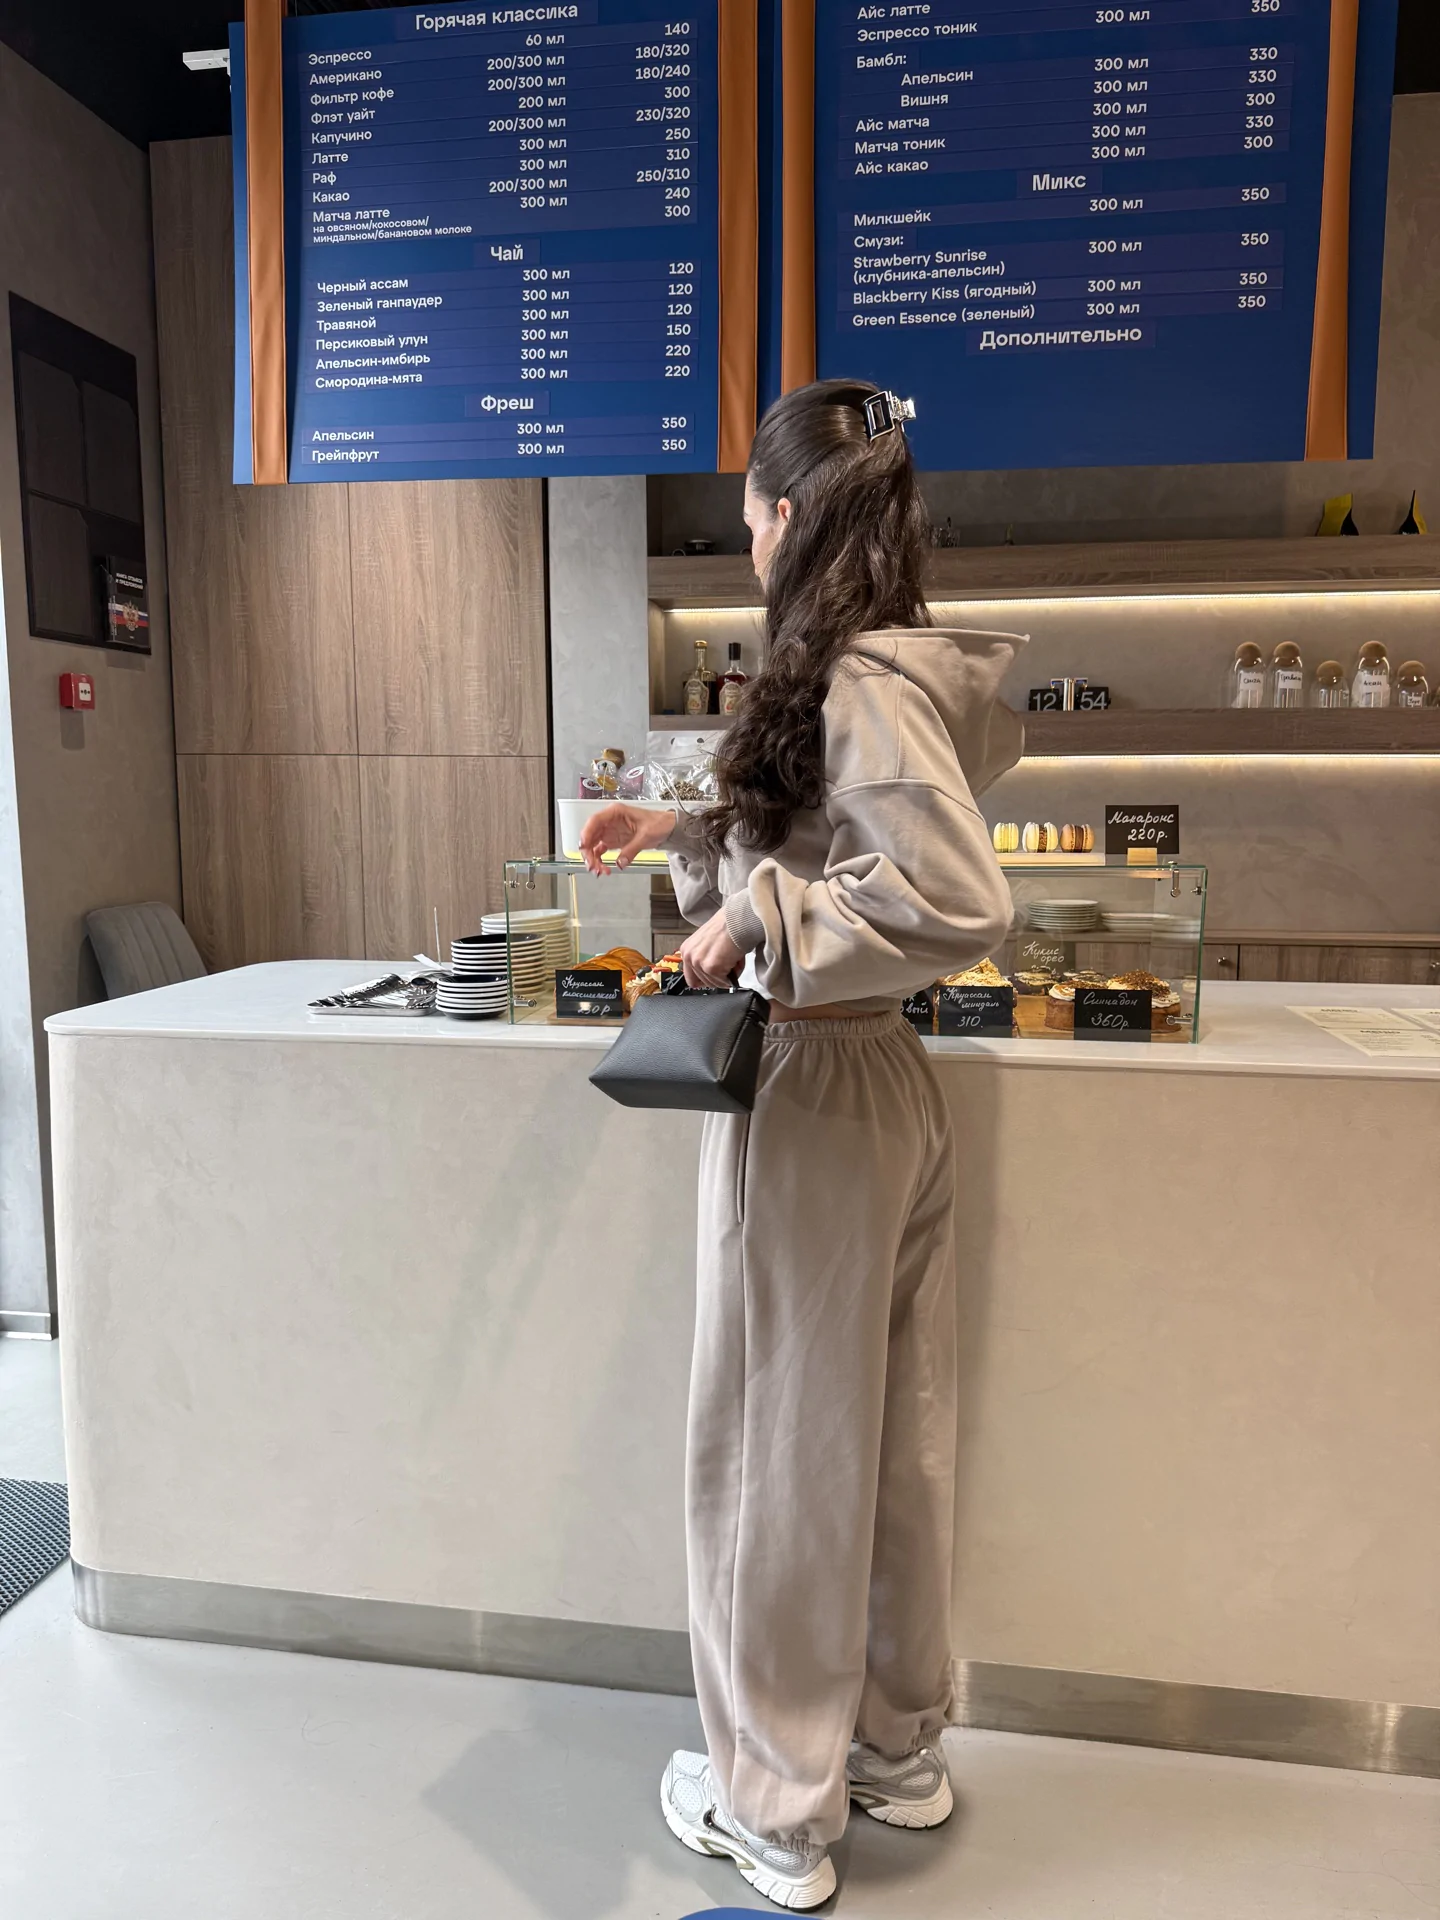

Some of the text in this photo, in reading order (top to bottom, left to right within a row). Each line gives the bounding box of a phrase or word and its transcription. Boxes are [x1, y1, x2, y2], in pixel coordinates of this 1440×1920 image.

[415, 4, 578, 33] Горячая классика
[856, 4, 931, 20] Айс латте
[857, 0, 1280, 43] Эспрессо тоник 300 мл 350
[308, 22, 690, 66] Эспрессо 60 мл 140
[309, 43, 690, 86] Американо 200/300 мл 180/320
[856, 52, 907, 69] Бамбл:
[900, 46, 1278, 87] Апельсин 300 мл 330
[310, 63, 691, 106] Фильтр кофе 200/300 мл 180/240
[900, 69, 1277, 108] Вишня 300 мл 330
[310, 85, 691, 125] Флэт уайт 200 мл 300
[855, 92, 1276, 133] Айс матча 300 мл 300
[311, 106, 691, 146] Капучино 200/300 мл 230/320
[854, 114, 1274, 155] Матча тоник 300 мл 330
[311, 127, 691, 165] Латте 300 мл 250
[854, 134, 1274, 175] Айс какао 300 мл 300
[312, 147, 691, 186] Раф 300 мл 310
[312, 167, 691, 204] Какао 200/300 мл 250/310
[1032, 173, 1087, 191] Микс
[313, 186, 691, 223] Матча латте 300 мл 240
[664, 204, 691, 218] 300
[853, 186, 1270, 227] Милкшейк 300 мл 350
[313, 216, 429, 234] на овсяном/кокосовом/
[313, 225, 473, 243] миндальном/банановом молоке
[490, 244, 524, 262] Чай
[853, 235, 904, 250] Смузи:
[853, 232, 1270, 269] Strawberry Sunrise 300 мл 350
[317, 261, 694, 296] Черный ассам 300 мл 120
[853, 260, 1006, 286] (клубника-апельсин)
[317, 282, 694, 313] Зеленый ганпаудер 300 мл 120
[853, 271, 1268, 305] Blackberry Kiss (ягодный) 300 мл 350
[315, 303, 693, 334] Травяной 300 мл 120
[852, 294, 1267, 327] Green Essence (зеленый) 300 мл 350
[315, 323, 692, 352] Персиковый улун 300 мл 150
[979, 328, 1142, 351] Дополнительно
[315, 344, 691, 370] Апельсин-имбирь 300 мл 220
[315, 364, 691, 390] Смородина-мята 300 мл 220
[480, 394, 534, 415] Фреш
[311, 416, 687, 442] Апельсин 300 мл 350
[311, 438, 687, 464] Грейпфрут 300 мл 350
[1033, 691, 1108, 711] 12 54
[1108, 811, 1174, 829] Макаронс
[1023, 941, 1059, 959] Кукис
[1041, 955, 1064, 965] орео
[562, 974, 604, 988] Круассан
[943, 987, 992, 1003] Круассан
[1083, 992, 1138, 1006] Синнабон
